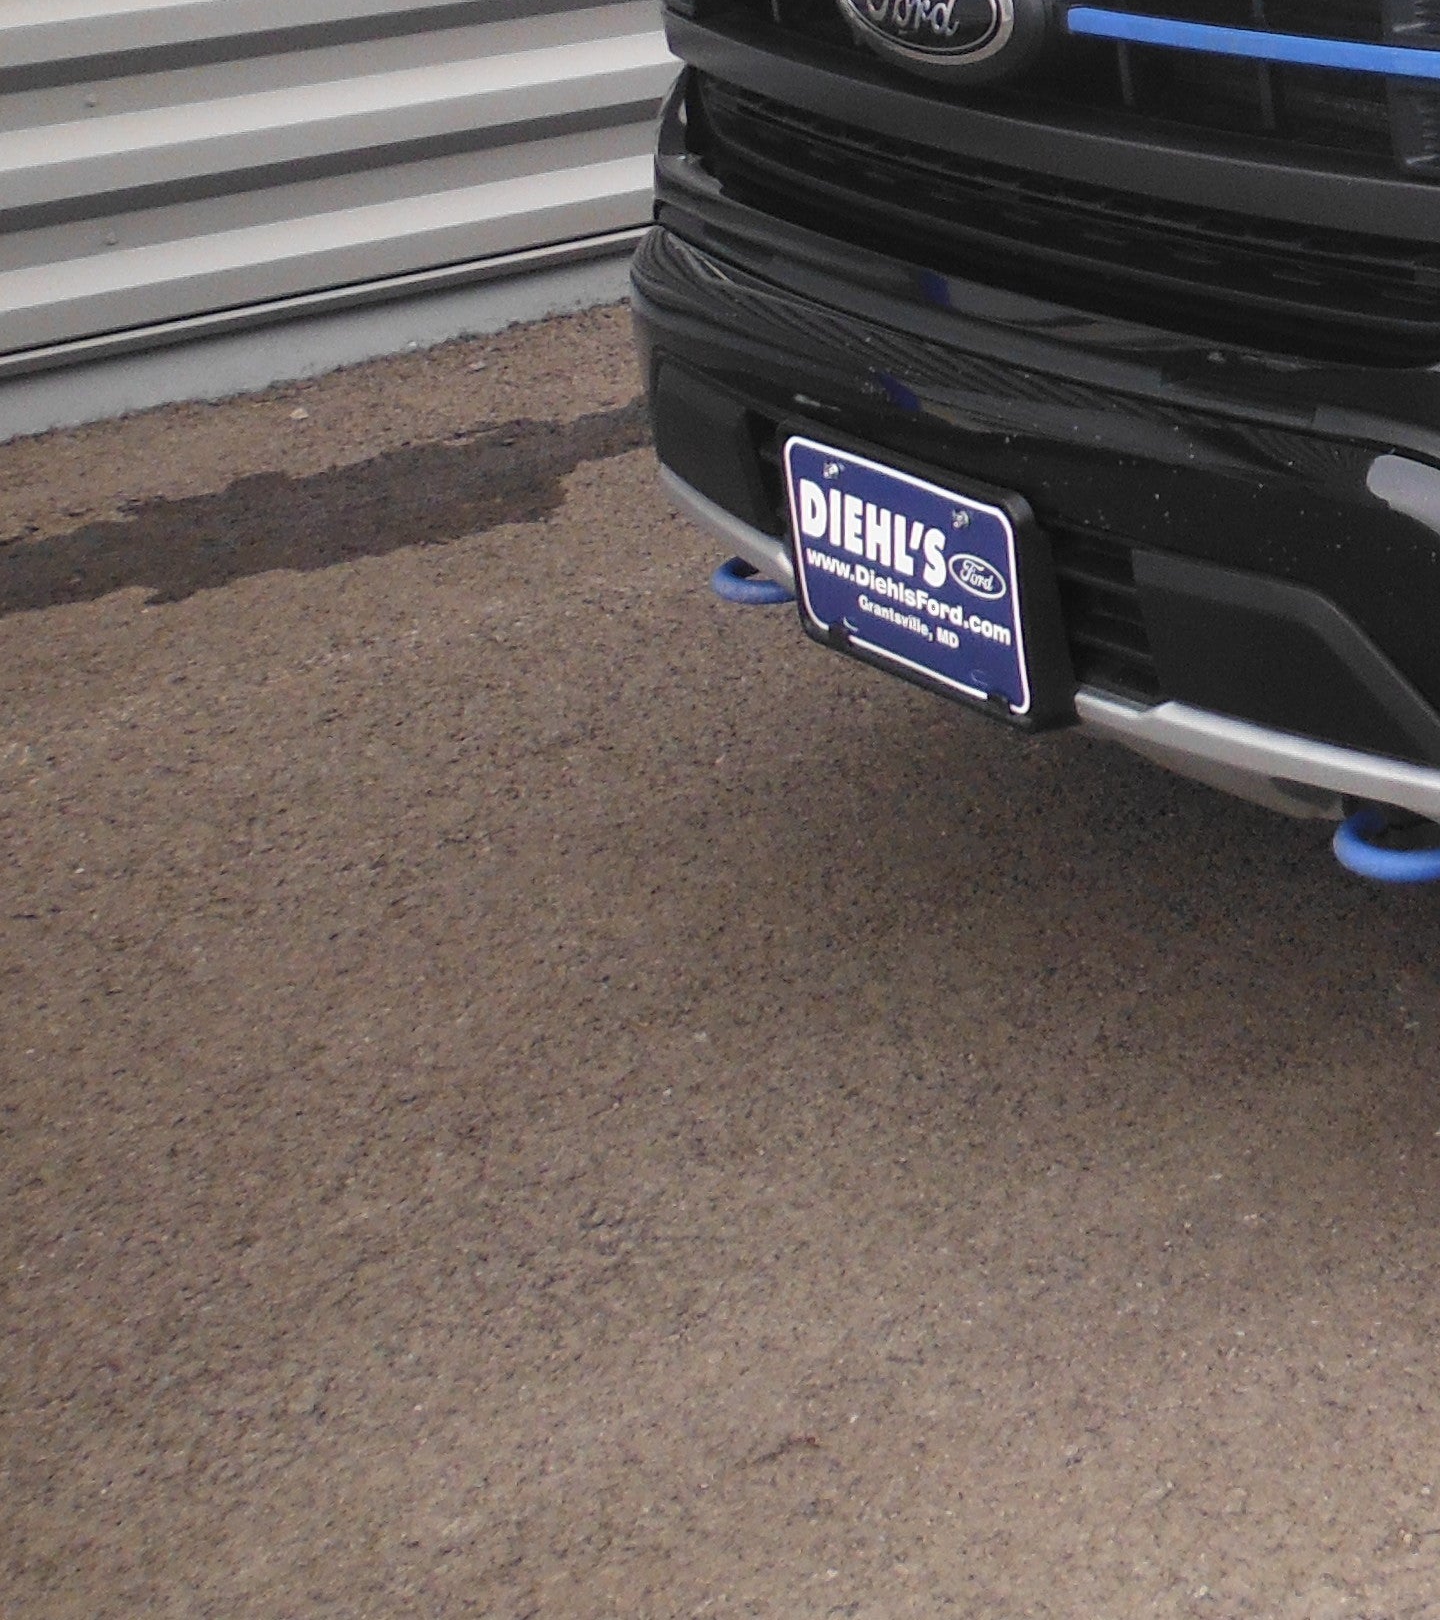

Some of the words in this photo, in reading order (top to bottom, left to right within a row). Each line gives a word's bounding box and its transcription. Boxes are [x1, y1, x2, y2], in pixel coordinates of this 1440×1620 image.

[801, 478, 947, 588] DIEHL'S
[806, 547, 1011, 646] www.DiehlsFord.com
[960, 558, 994, 592] Ford
[858, 595, 934, 642] Grantsville,
[937, 626, 960, 649] MD
